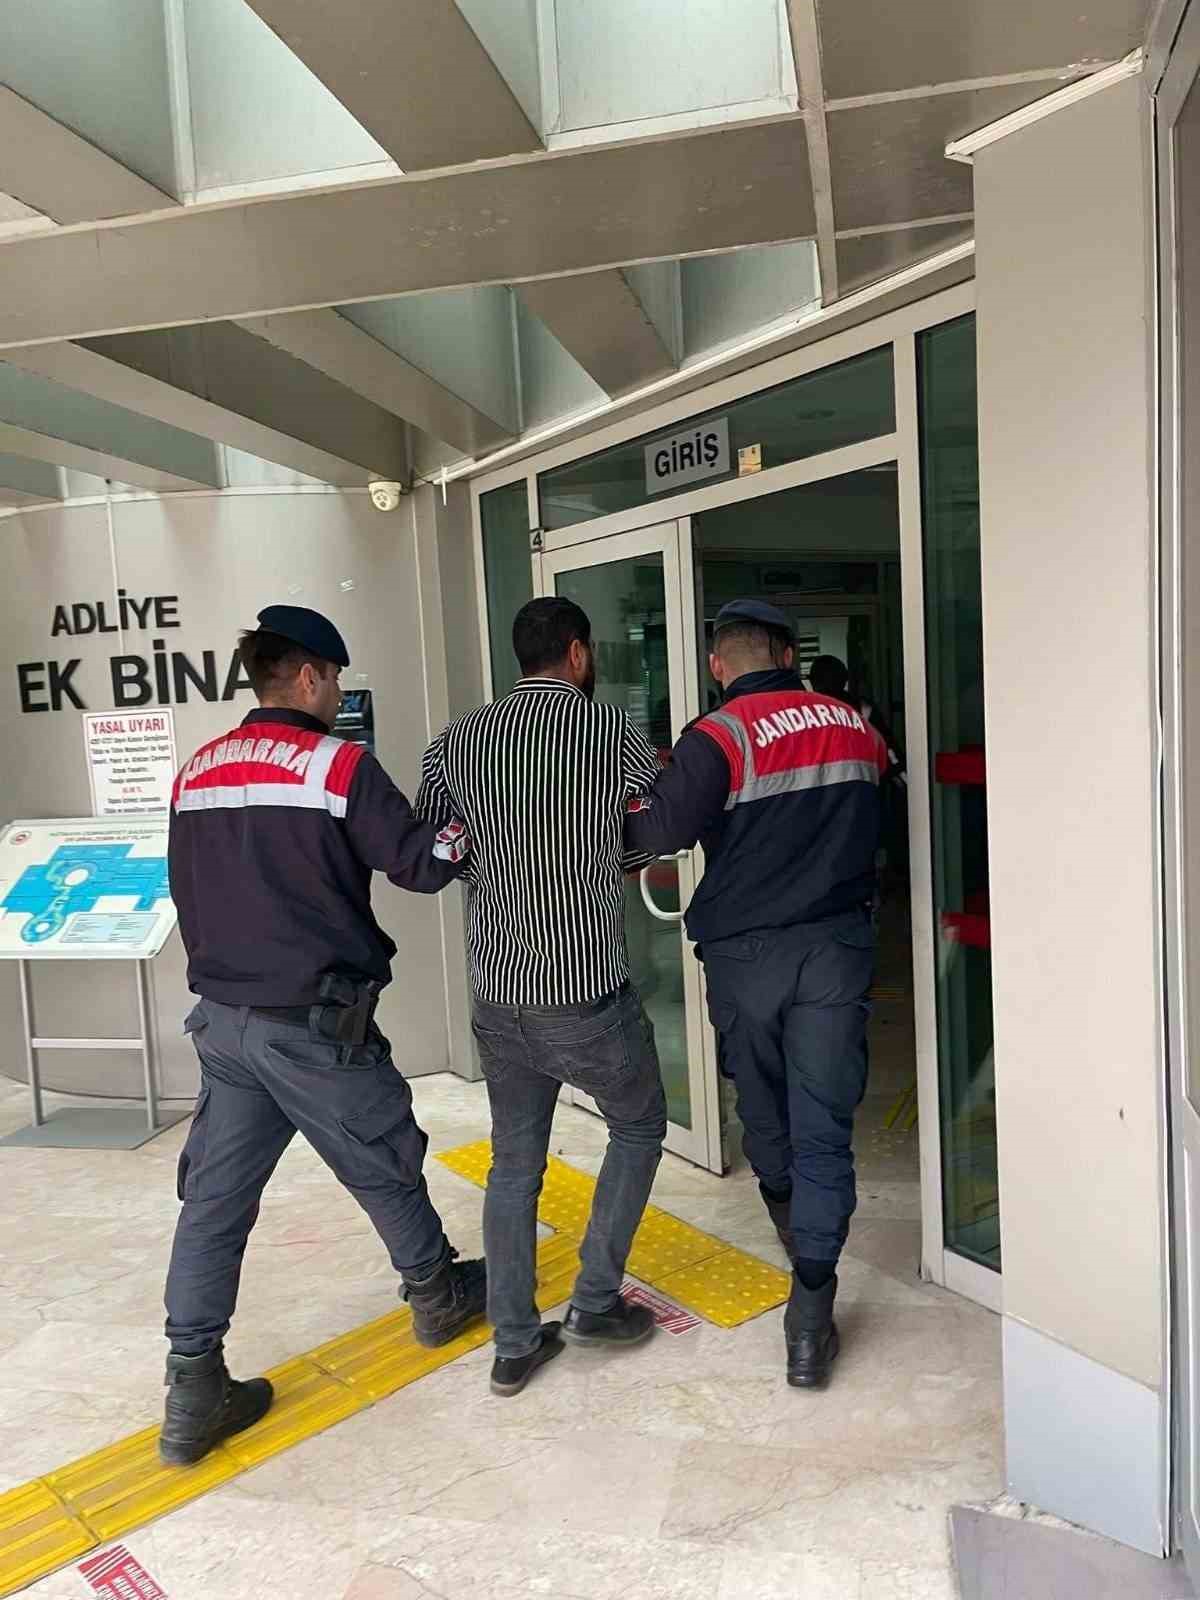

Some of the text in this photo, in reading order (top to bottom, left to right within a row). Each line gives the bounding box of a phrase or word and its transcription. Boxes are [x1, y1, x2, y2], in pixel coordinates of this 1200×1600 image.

[654, 432, 719, 478] GİRİŞ
[533, 532, 542, 546] 4
[51, 589, 180, 637] ADLİYE
[17, 659, 87, 713] EK
[91, 718, 165, 735] YASAL UYARI
[752, 703, 867, 748] JANDARMA
[186, 737, 313, 780] JANDARMA
